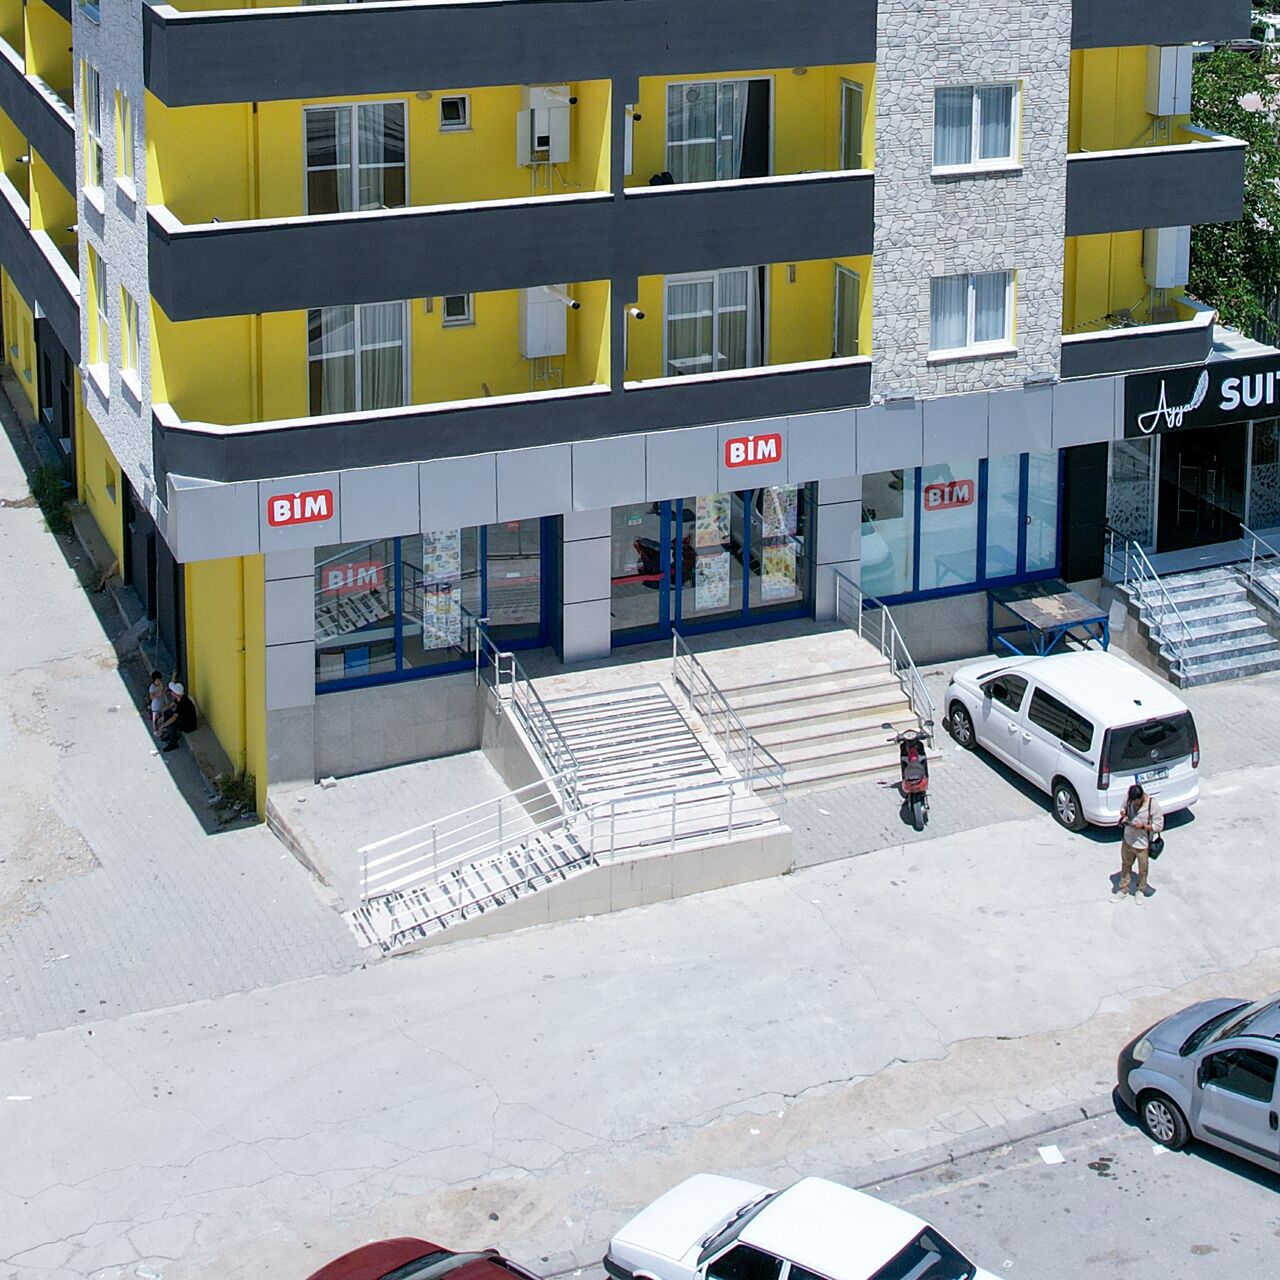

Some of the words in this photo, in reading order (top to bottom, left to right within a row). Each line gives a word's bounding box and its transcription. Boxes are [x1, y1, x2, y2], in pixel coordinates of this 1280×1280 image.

[730, 435, 777, 464] BİM
[273, 492, 328, 522] BİM
[328, 564, 378, 590] BİM
